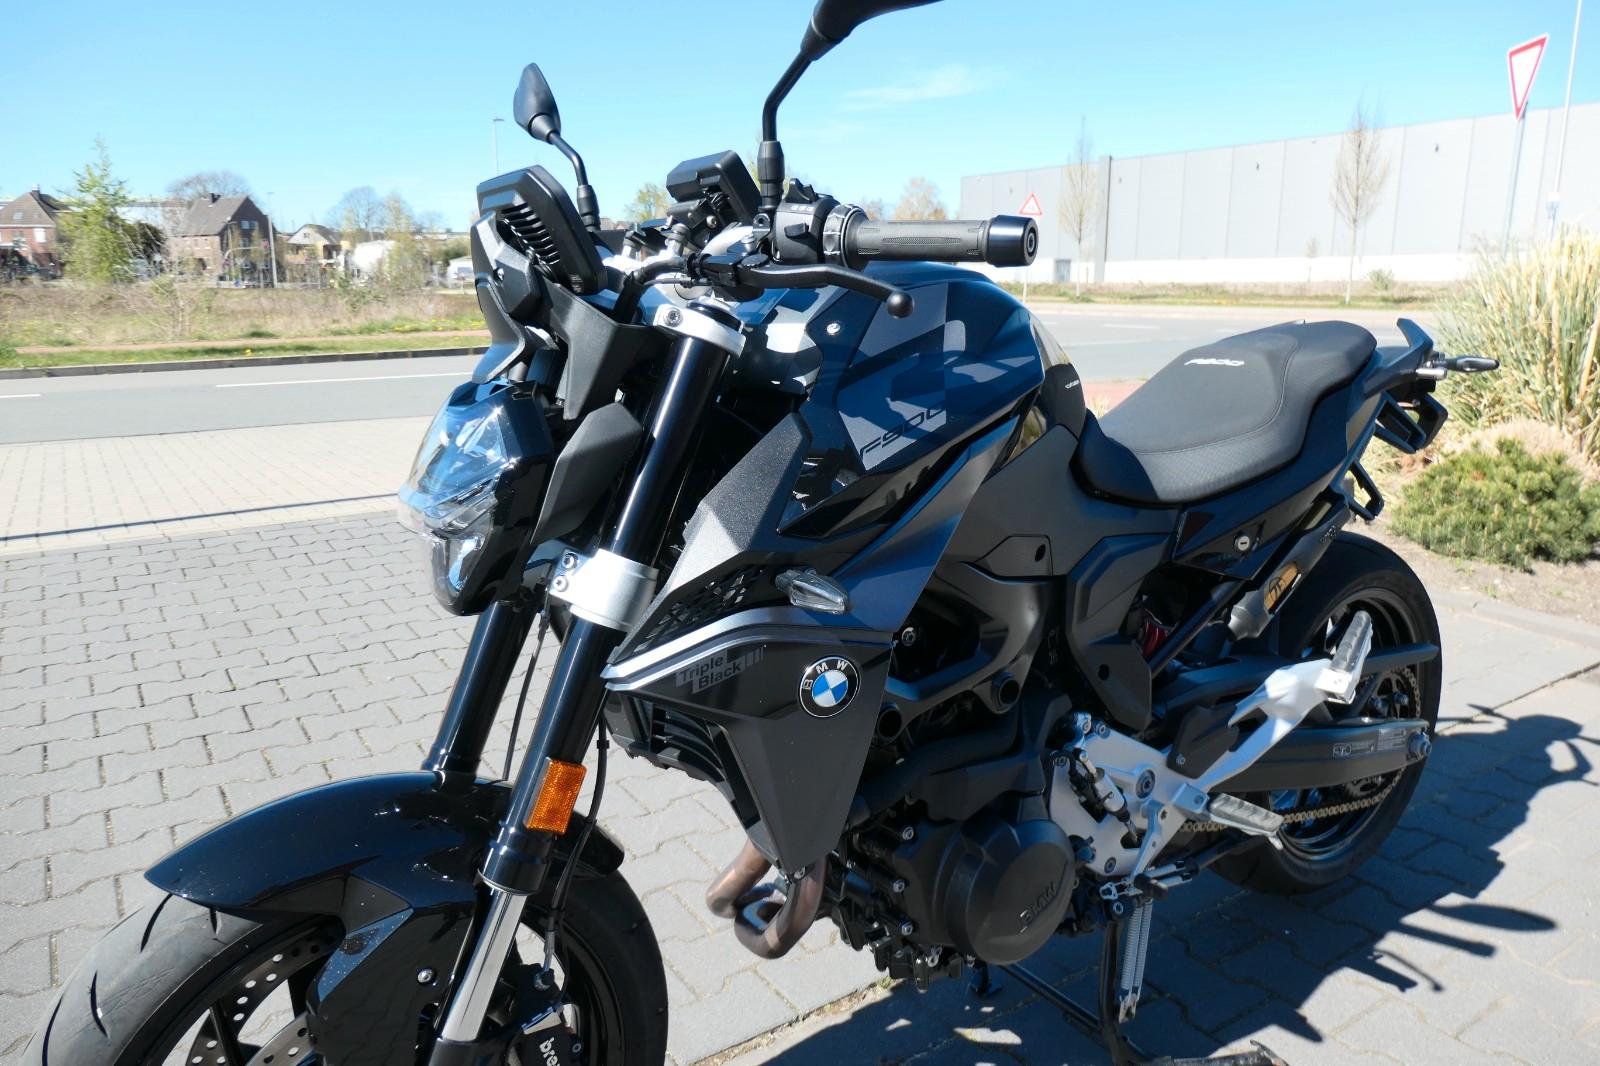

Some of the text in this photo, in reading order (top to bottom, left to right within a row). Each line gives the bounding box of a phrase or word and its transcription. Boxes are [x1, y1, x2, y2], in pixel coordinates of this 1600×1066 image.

[680, 656, 723, 681] Triple
[698, 662, 741, 688] Black
[802, 660, 848, 690] BMW
[1018, 881, 1058, 933] BMW
[539, 1036, 561, 1066] bre
